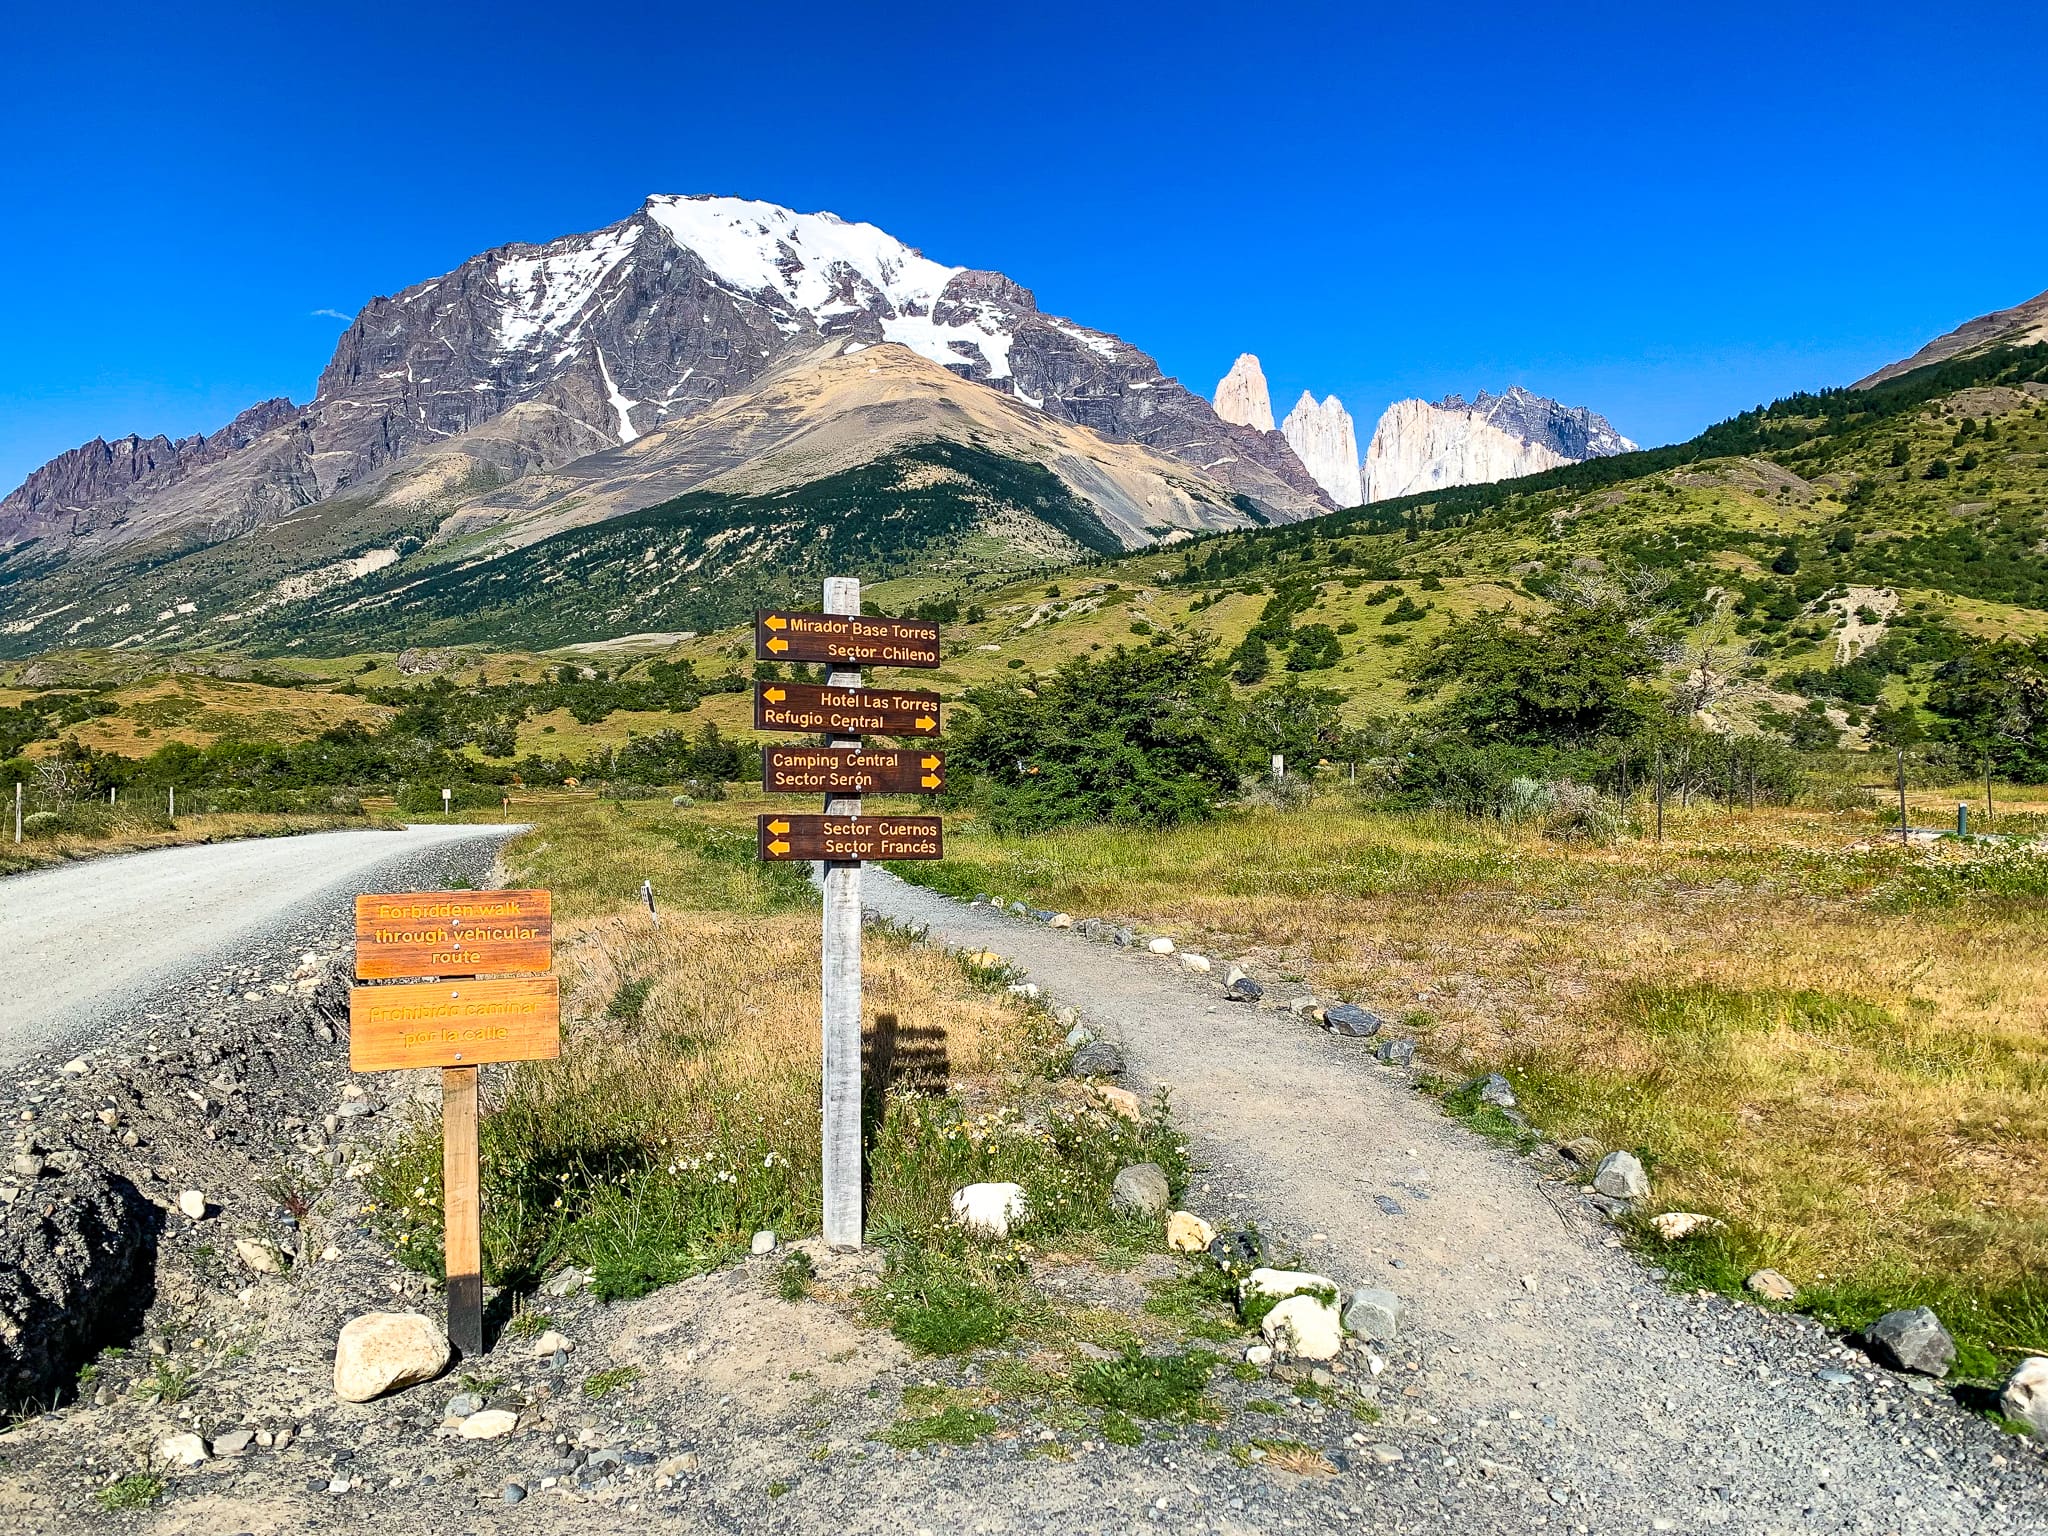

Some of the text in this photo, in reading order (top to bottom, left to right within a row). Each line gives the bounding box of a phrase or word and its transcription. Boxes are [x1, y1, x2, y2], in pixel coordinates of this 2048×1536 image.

[790, 618, 937, 640] Mirador Base Torres
[828, 644, 936, 662] Sector Chileno
[821, 692, 938, 712] Hotel Las Torres
[765, 709, 884, 729] Refugio Central
[773, 753, 898, 770] Camping Central
[775, 771, 872, 786] Sector Serón
[823, 822, 937, 836] Sector Cuernos
[825, 839, 937, 854] Sector Francés
[379, 901, 521, 919] Forbidden walk
[375, 926, 539, 945] through vehicular
[431, 950, 481, 964] route
[370, 1000, 541, 1023] Prohibido caminar
[404, 1026, 508, 1048] por la calle
